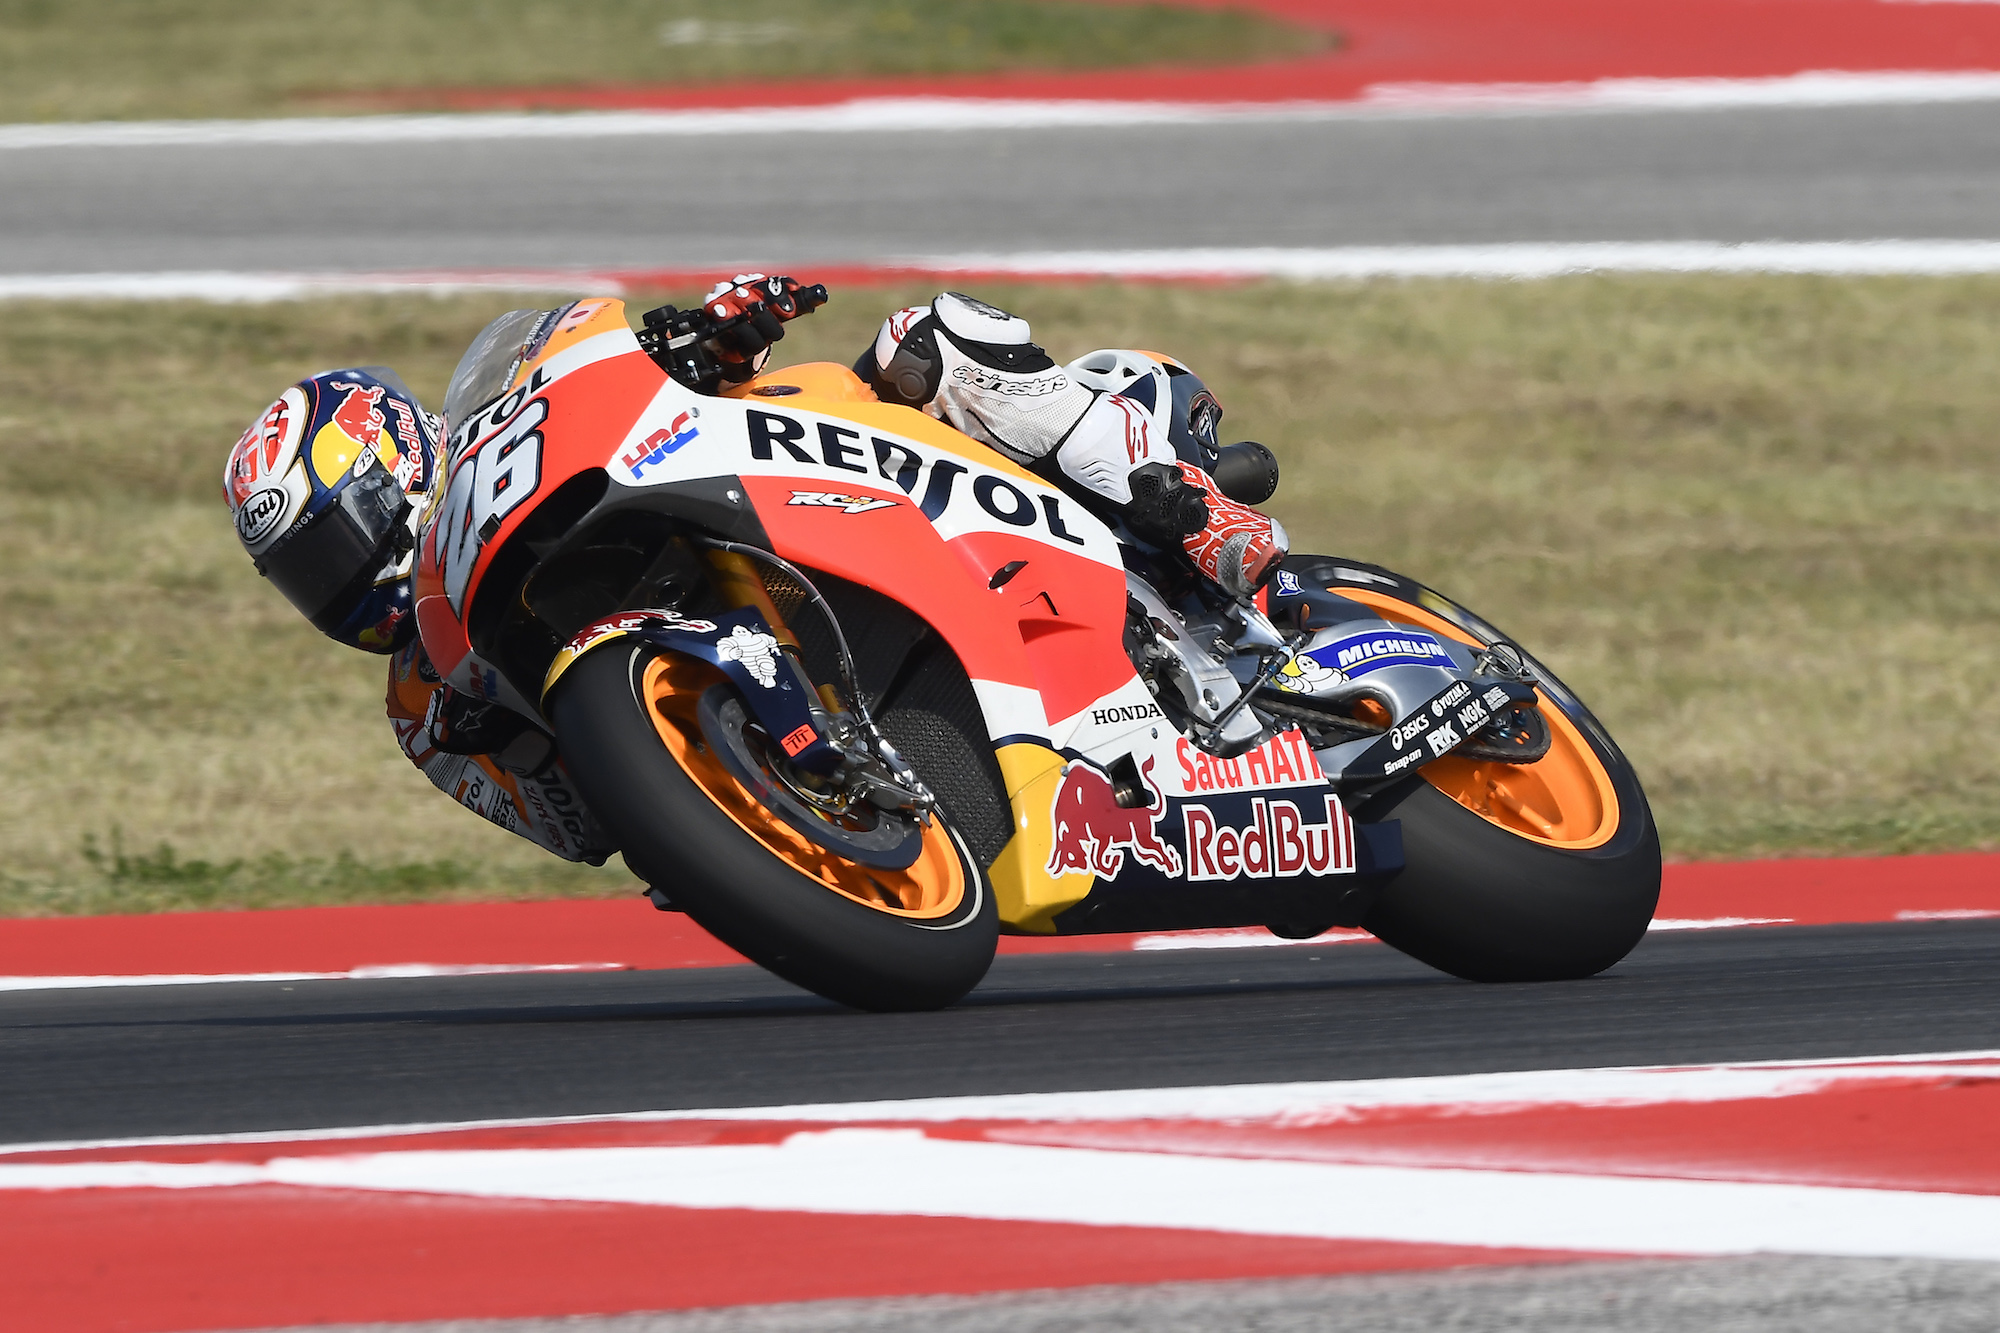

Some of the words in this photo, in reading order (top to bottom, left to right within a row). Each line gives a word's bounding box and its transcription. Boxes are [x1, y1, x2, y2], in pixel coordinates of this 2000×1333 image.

[621, 411, 700, 480] HRC
[244, 490, 276, 531] Arai
[283, 511, 314, 540] WINGS
[1281, 572, 1298, 591] GAS
[1338, 640, 1446, 667] MICHELIN
[1091, 703, 1162, 725] HONDA
[1457, 698, 1487, 729] NGK
[1426, 720, 1460, 753] RK
[1176, 737, 1243, 792] Satu
[1384, 748, 1422, 776] Snap-on
